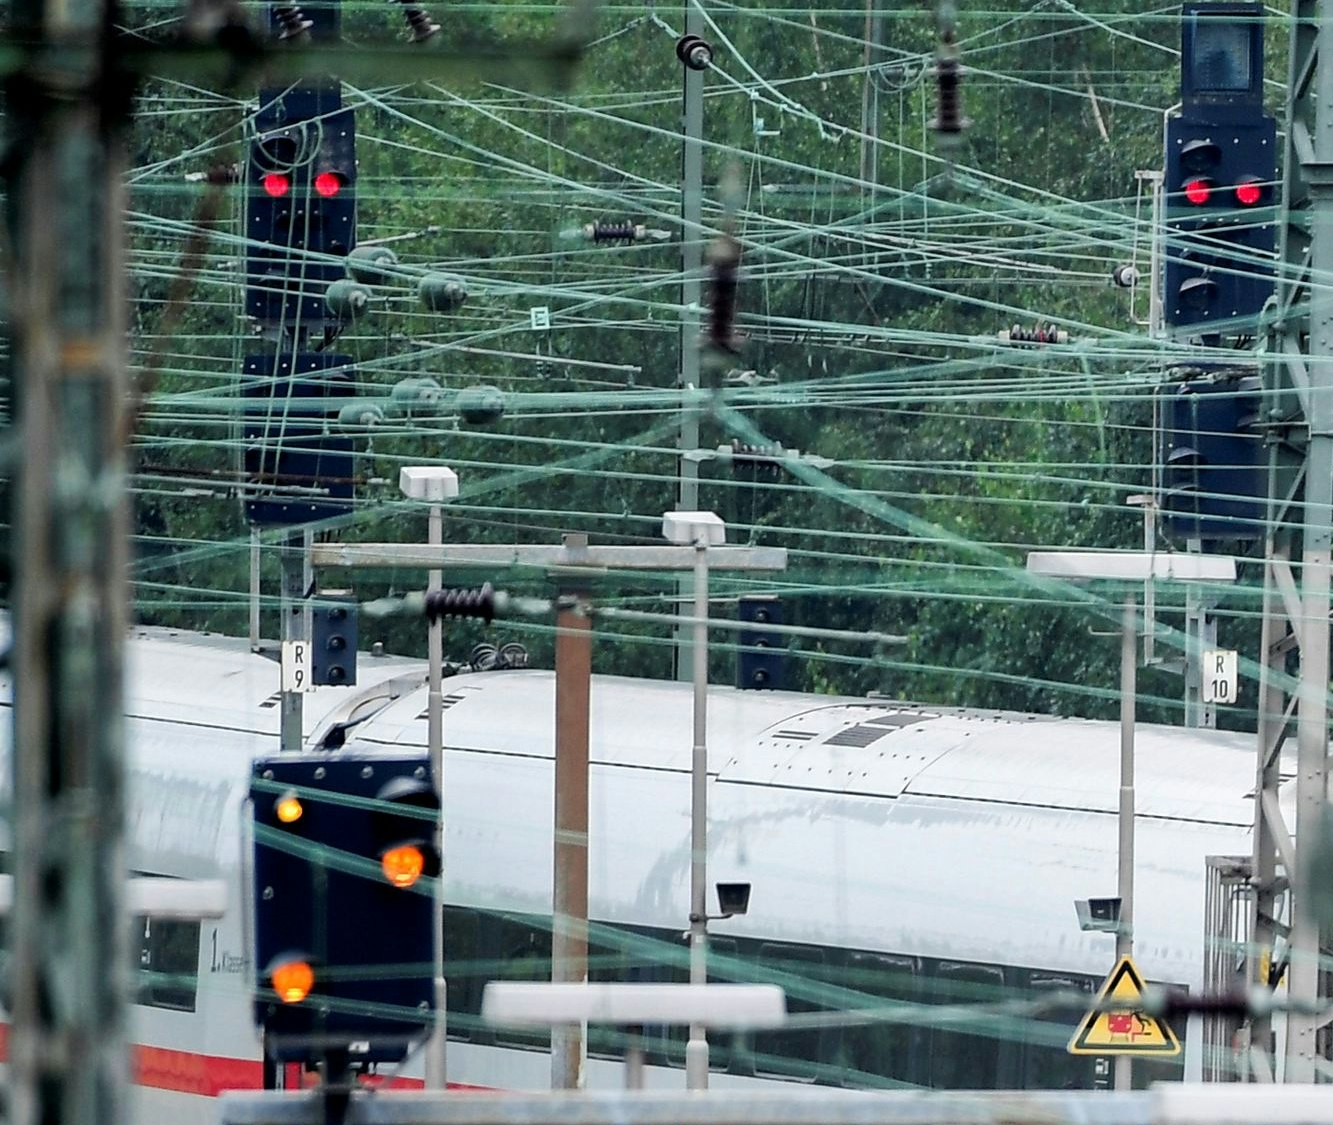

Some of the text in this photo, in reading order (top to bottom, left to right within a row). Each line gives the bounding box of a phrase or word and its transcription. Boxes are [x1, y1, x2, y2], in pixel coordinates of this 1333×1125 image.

[295, 645, 304, 664] R
[1215, 655, 1224, 674] R
[295, 669, 304, 688] 9
[1211, 679, 1228, 698] 10
